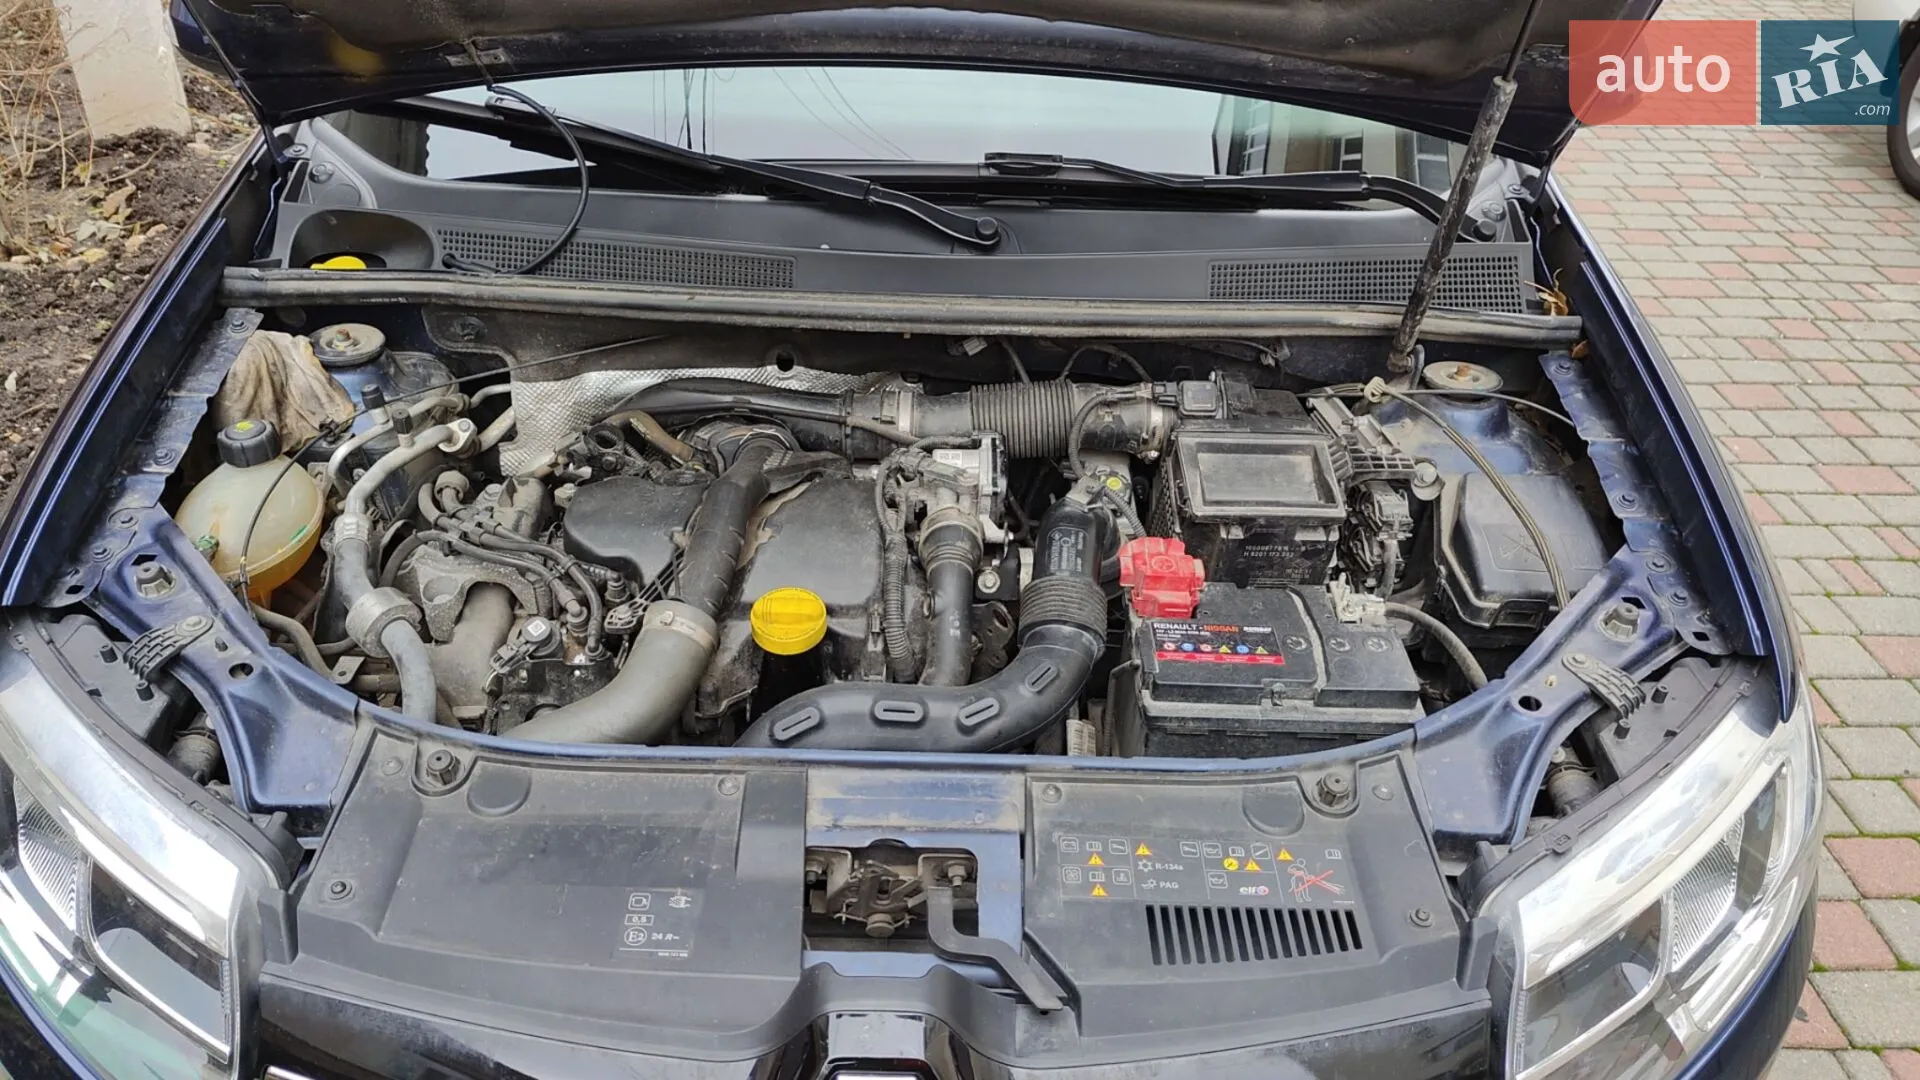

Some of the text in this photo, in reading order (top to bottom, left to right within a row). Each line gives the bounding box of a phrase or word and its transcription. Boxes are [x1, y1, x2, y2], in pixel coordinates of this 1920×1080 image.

[1153, 623, 1197, 631] RENAULT
[1203, 624, 1239, 633] NISSAN
[1155, 863, 1184, 871] R-134a
[1160, 881, 1179, 889] PAG
[1239, 886, 1258, 895] elf
